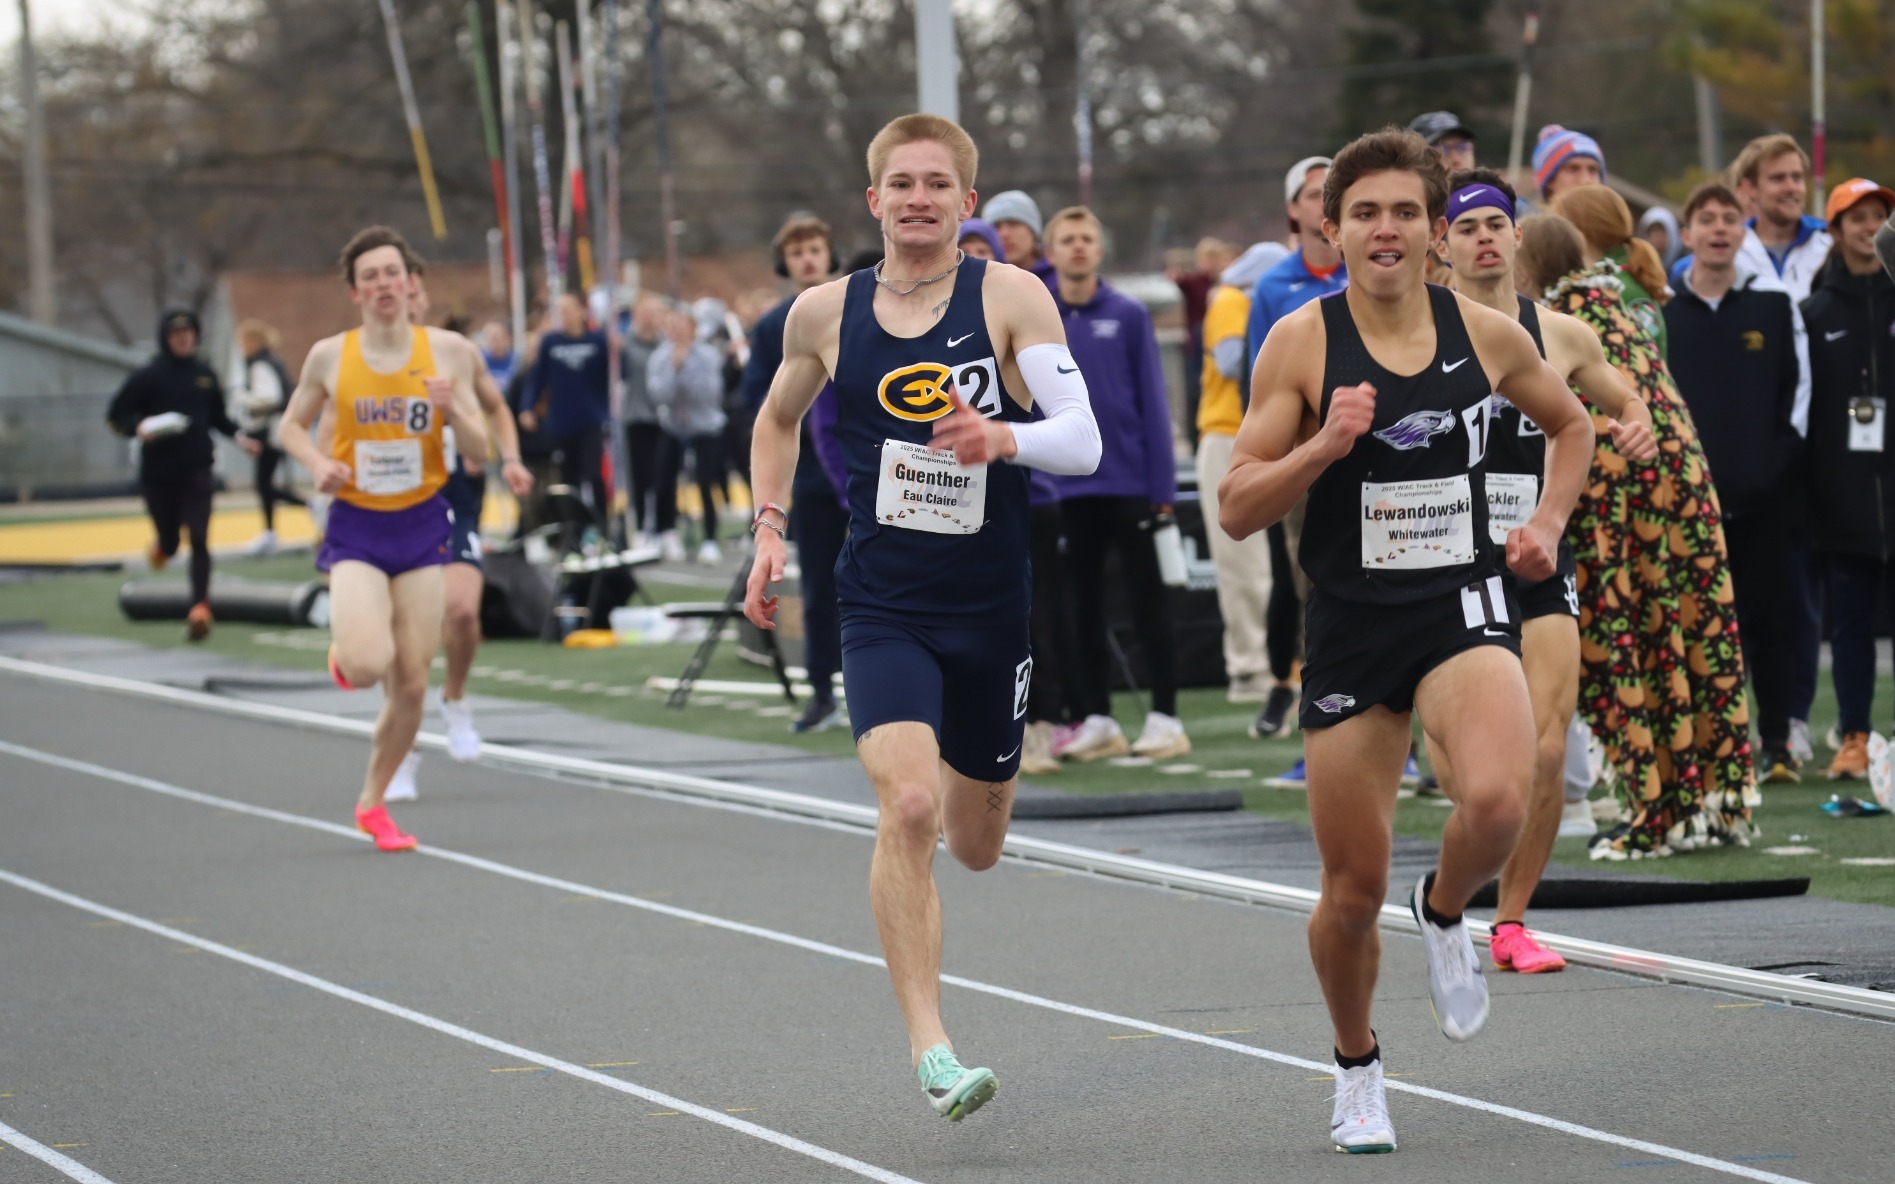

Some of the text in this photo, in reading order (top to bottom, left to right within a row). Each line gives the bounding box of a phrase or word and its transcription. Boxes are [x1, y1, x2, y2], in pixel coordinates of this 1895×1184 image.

[959, 365, 996, 415] 2
[355, 395, 404, 424] UWS
[410, 401, 429, 432] 8
[1471, 405, 1485, 458] 1
[900, 444, 914, 452] 2025
[932, 450, 948, 458] Track
[911, 453, 957, 466] Championships
[895, 463, 970, 488] Guenther
[903, 489, 957, 506] Eau Claire
[1394, 489, 1443, 498] Championships
[1487, 491, 1520, 506] ckler
[1365, 497, 1470, 521] Lewandowski
[1489, 512, 1517, 521] ewater
[1388, 527, 1449, 541] Whitewater
[1467, 579, 1498, 623] 1
[1016, 661, 1031, 715] 2
